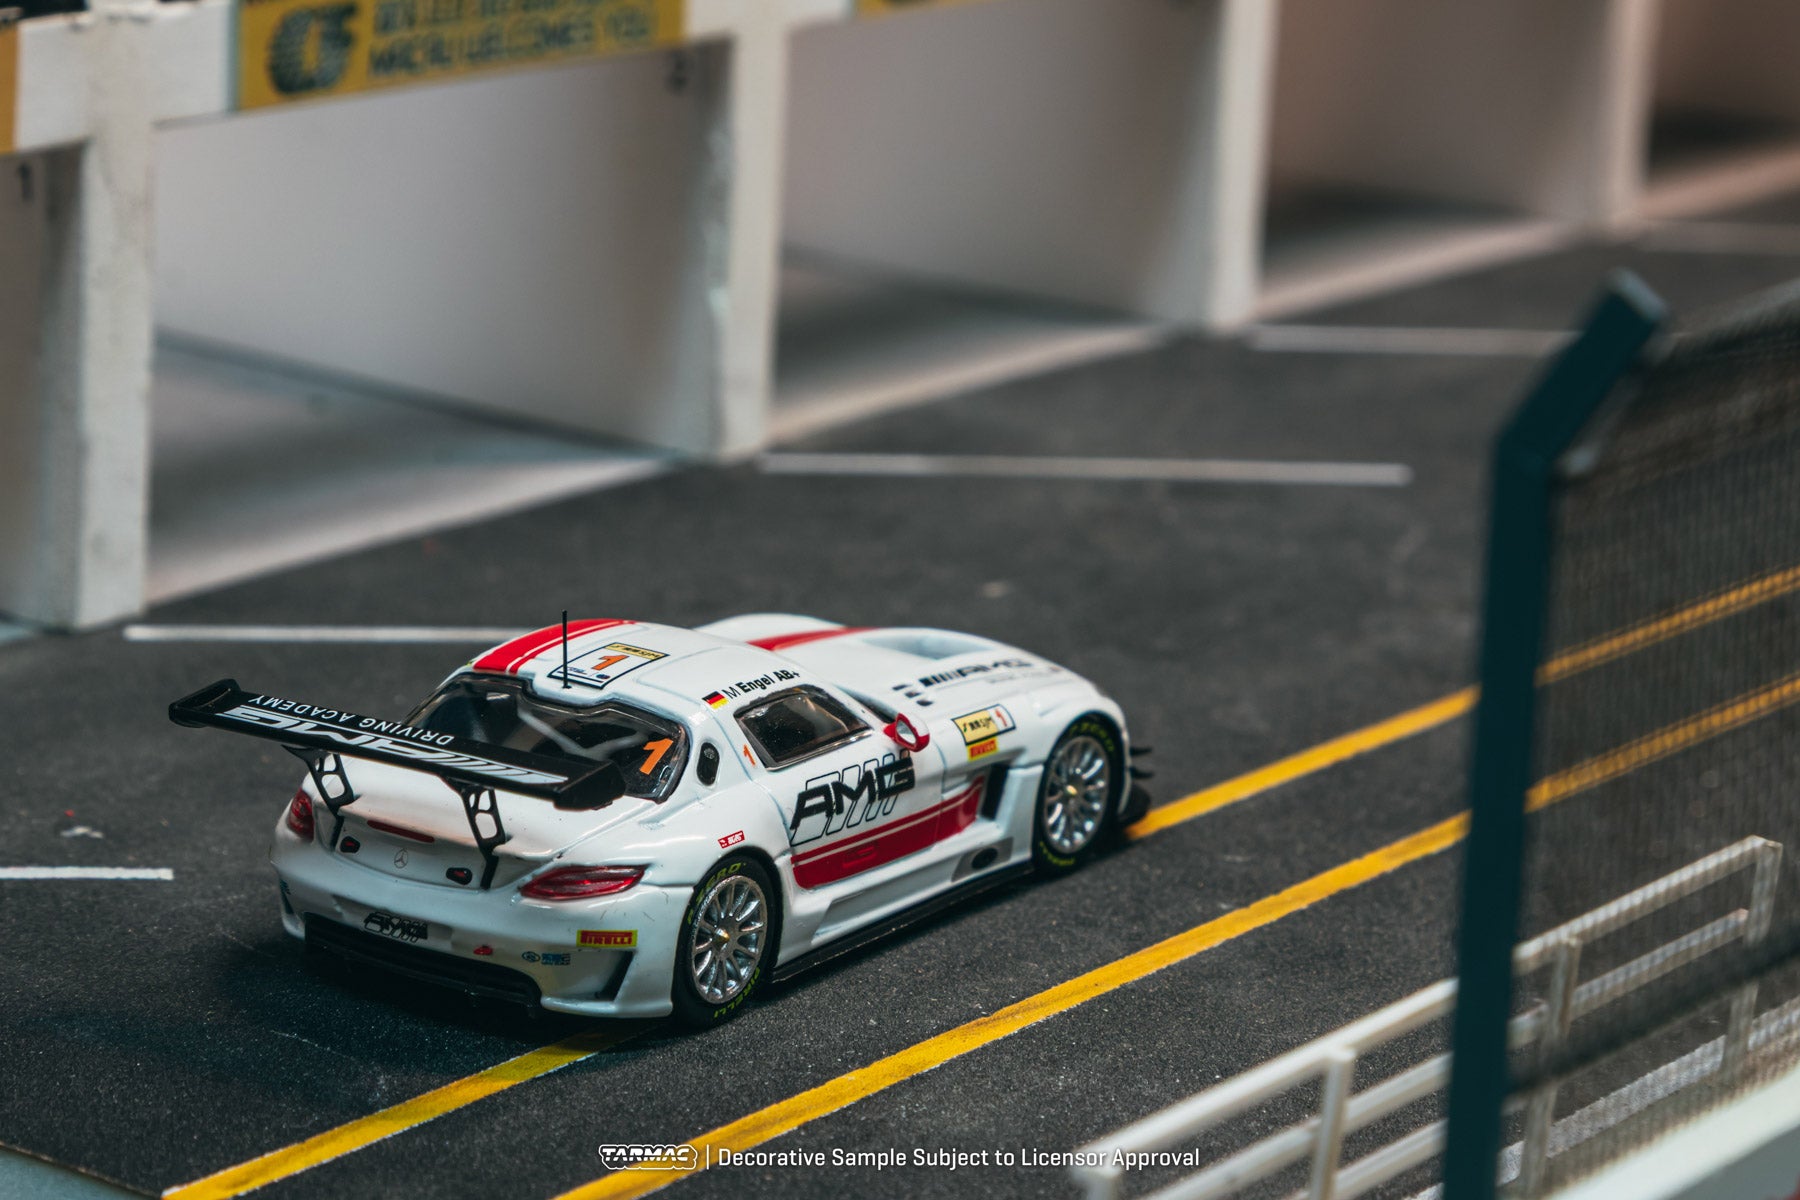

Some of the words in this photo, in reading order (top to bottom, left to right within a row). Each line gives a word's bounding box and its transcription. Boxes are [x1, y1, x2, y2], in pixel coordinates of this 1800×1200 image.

[591, 654, 630, 671] 1
[721, 686, 742, 699] M
[735, 674, 776, 693] Engel
[247, 694, 354, 723] ACADEMY
[994, 708, 1008, 727] 1
[359, 717, 455, 747] DRIVING
[639, 738, 674, 776] 1
[743, 744, 756, 766] 1
[789, 756, 916, 831] AMG
[713, 966, 761, 1019] PIRELLI
